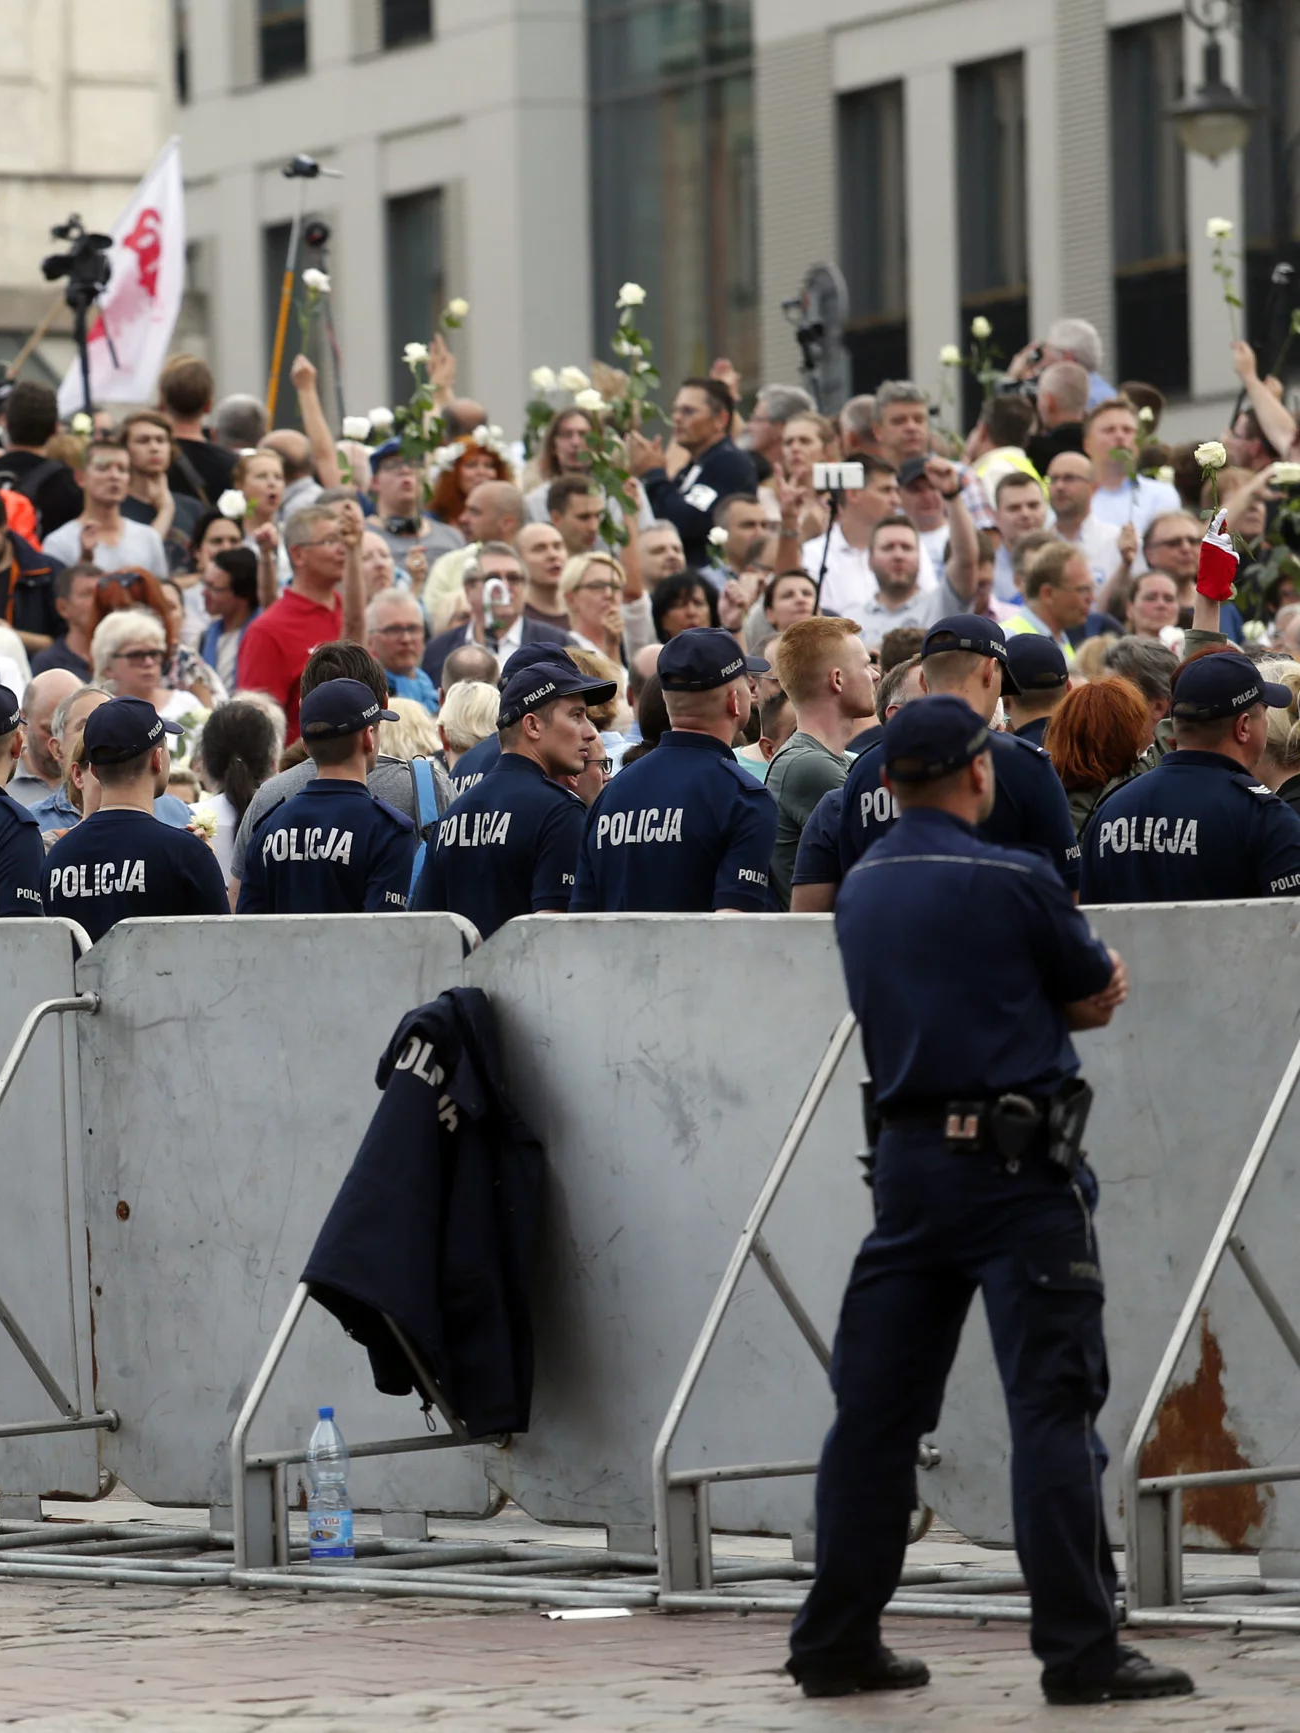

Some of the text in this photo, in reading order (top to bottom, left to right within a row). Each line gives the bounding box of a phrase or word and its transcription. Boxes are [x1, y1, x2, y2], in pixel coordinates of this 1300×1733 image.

[721, 658, 744, 678] POLICJA
[523, 682, 556, 706] POLICJA
[1232, 686, 1259, 707] POLICJA
[262, 826, 355, 868] POLICJA
[436, 810, 512, 852] POLICJA
[597, 807, 684, 850] POLICJA
[1099, 815, 1198, 859] POLICJA
[50, 859, 146, 902] POLICJA
